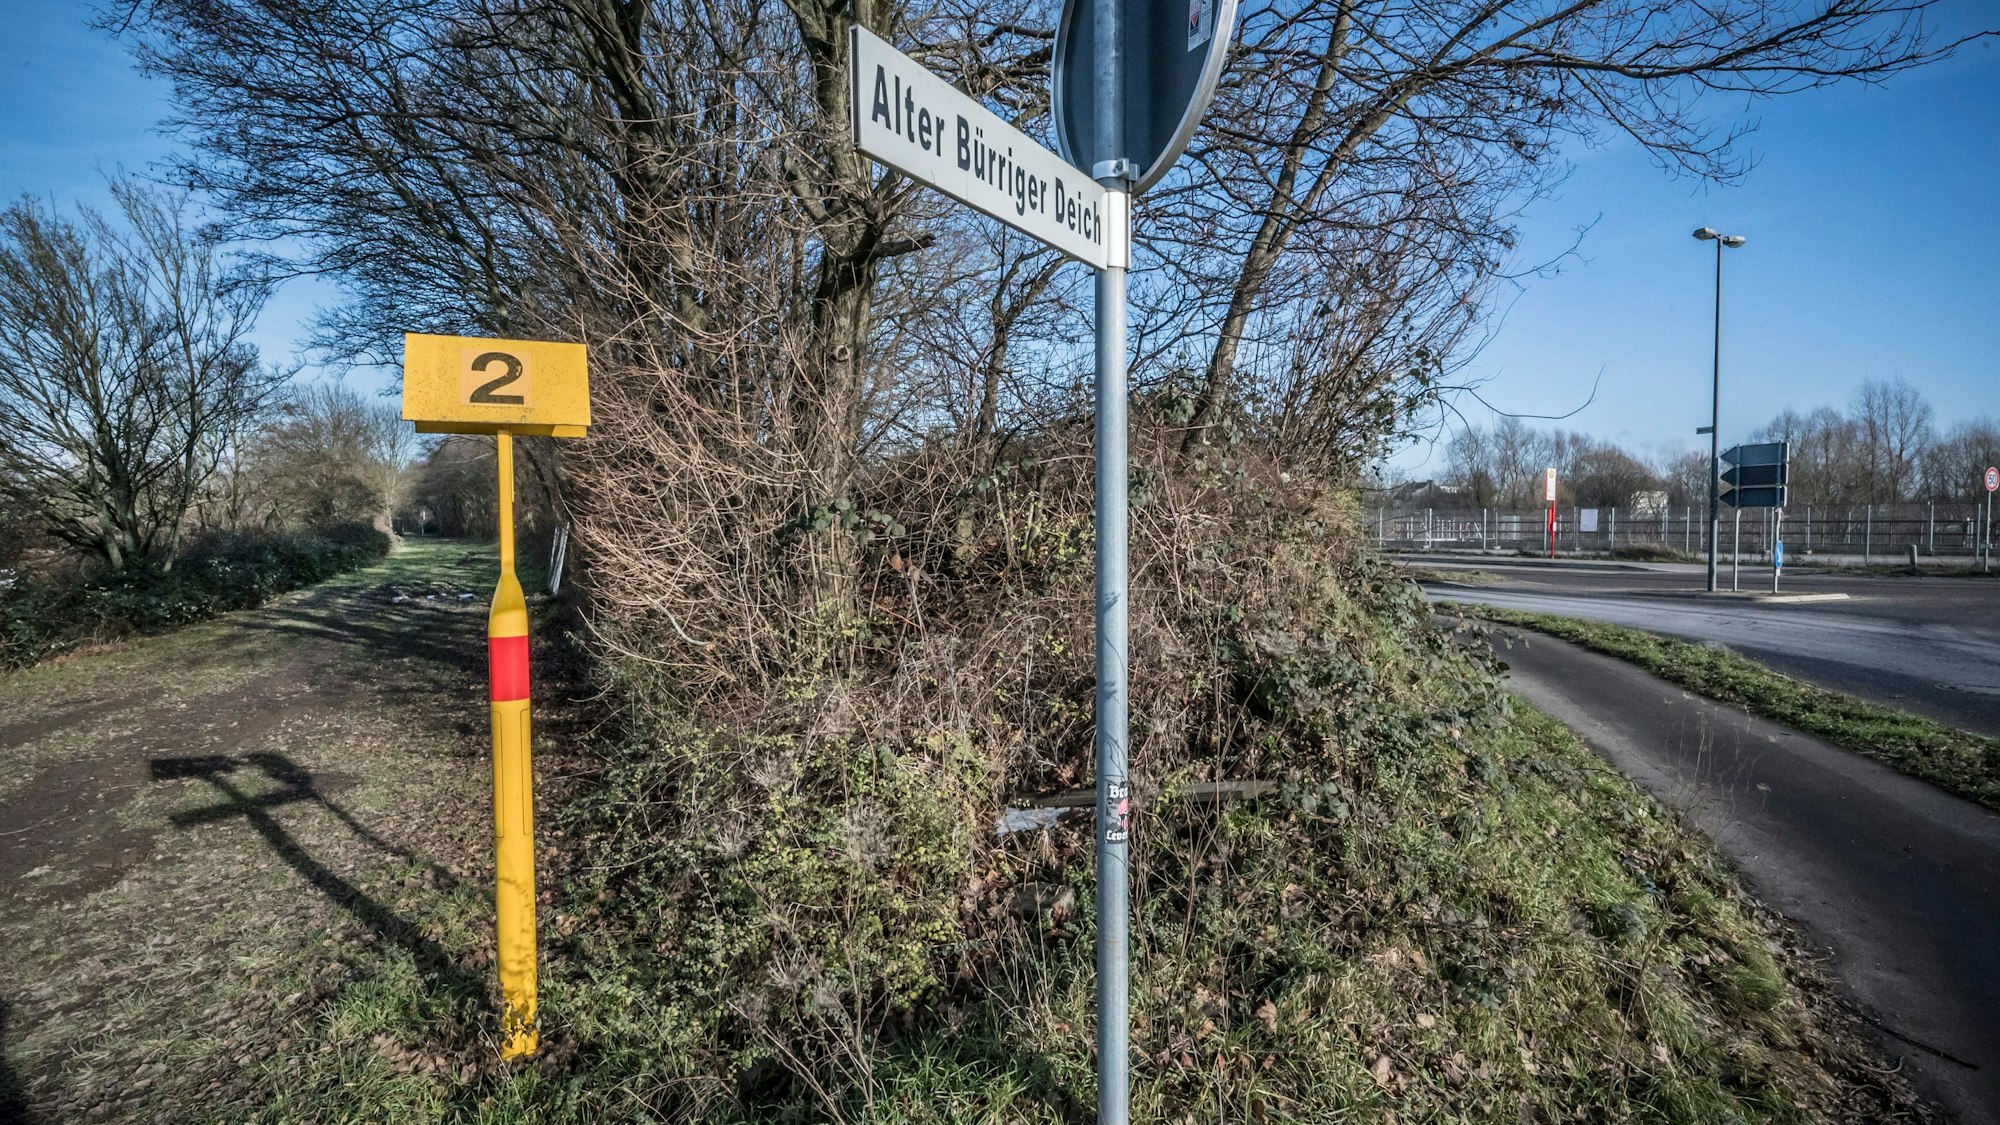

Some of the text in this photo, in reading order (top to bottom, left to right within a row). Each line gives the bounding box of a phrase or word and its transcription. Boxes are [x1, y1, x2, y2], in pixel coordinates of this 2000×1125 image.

[872, 64, 1101, 245] Alter Bürriger Deich
[470, 351, 525, 404] 2
[1988, 474, 1997, 485] 50
